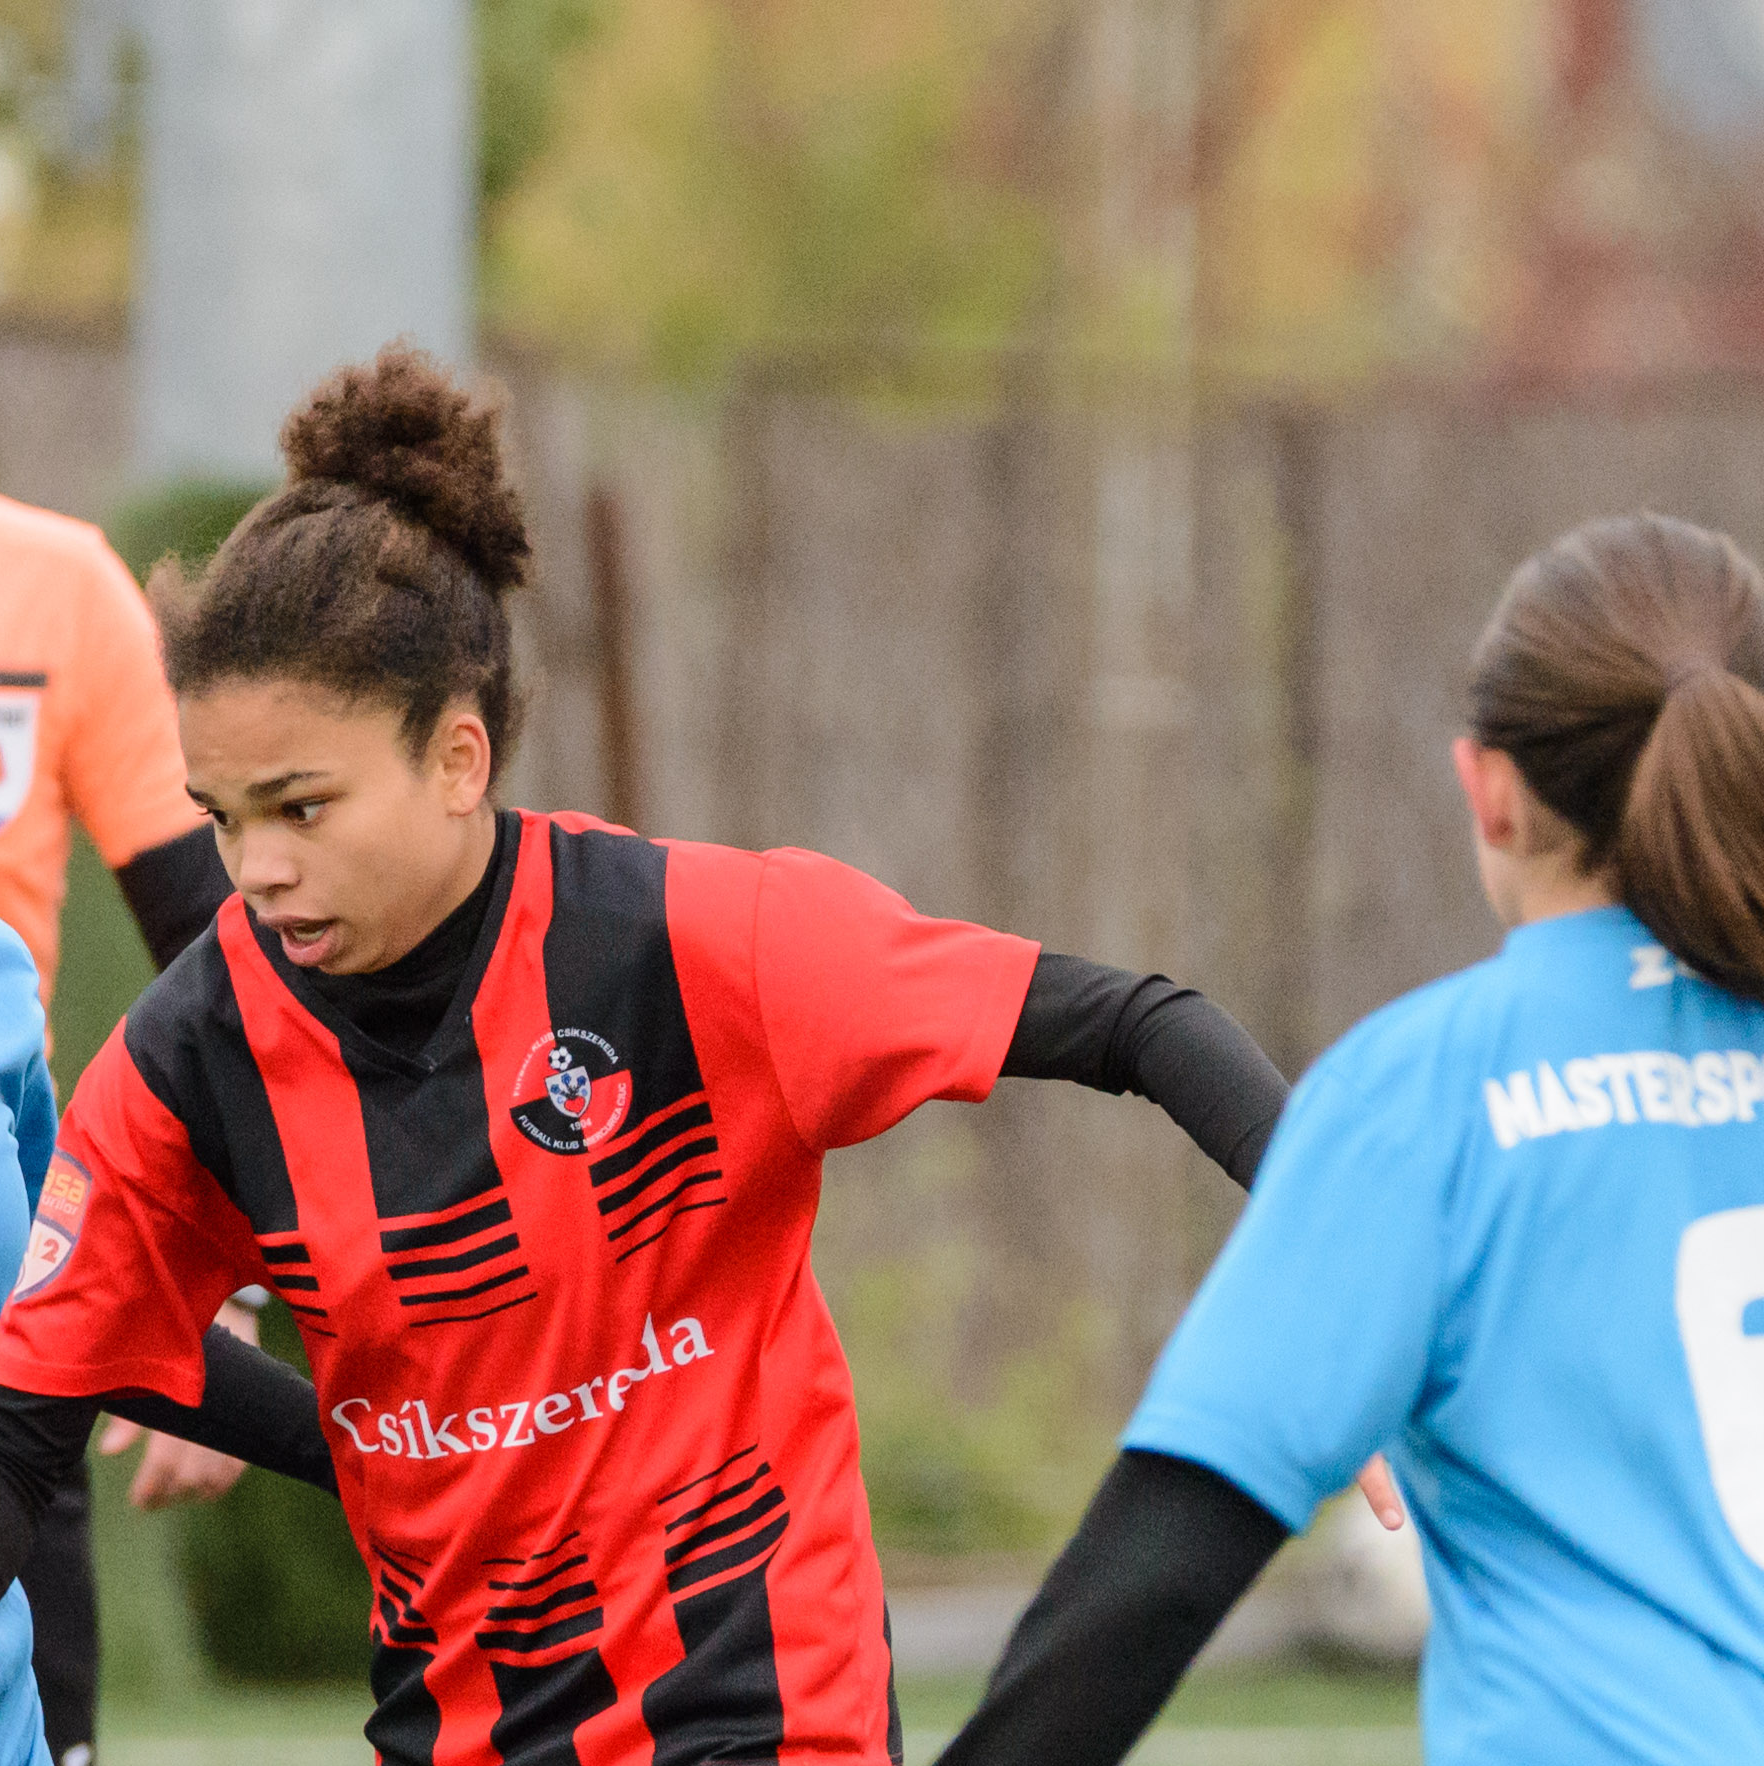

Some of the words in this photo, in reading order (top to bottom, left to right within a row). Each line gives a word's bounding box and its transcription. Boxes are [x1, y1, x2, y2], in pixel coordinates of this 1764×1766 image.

[518, 1114, 552, 1146] FUTBALL
[553, 1139, 580, 1149] KLUB
[40, 1238, 60, 1264] 2
